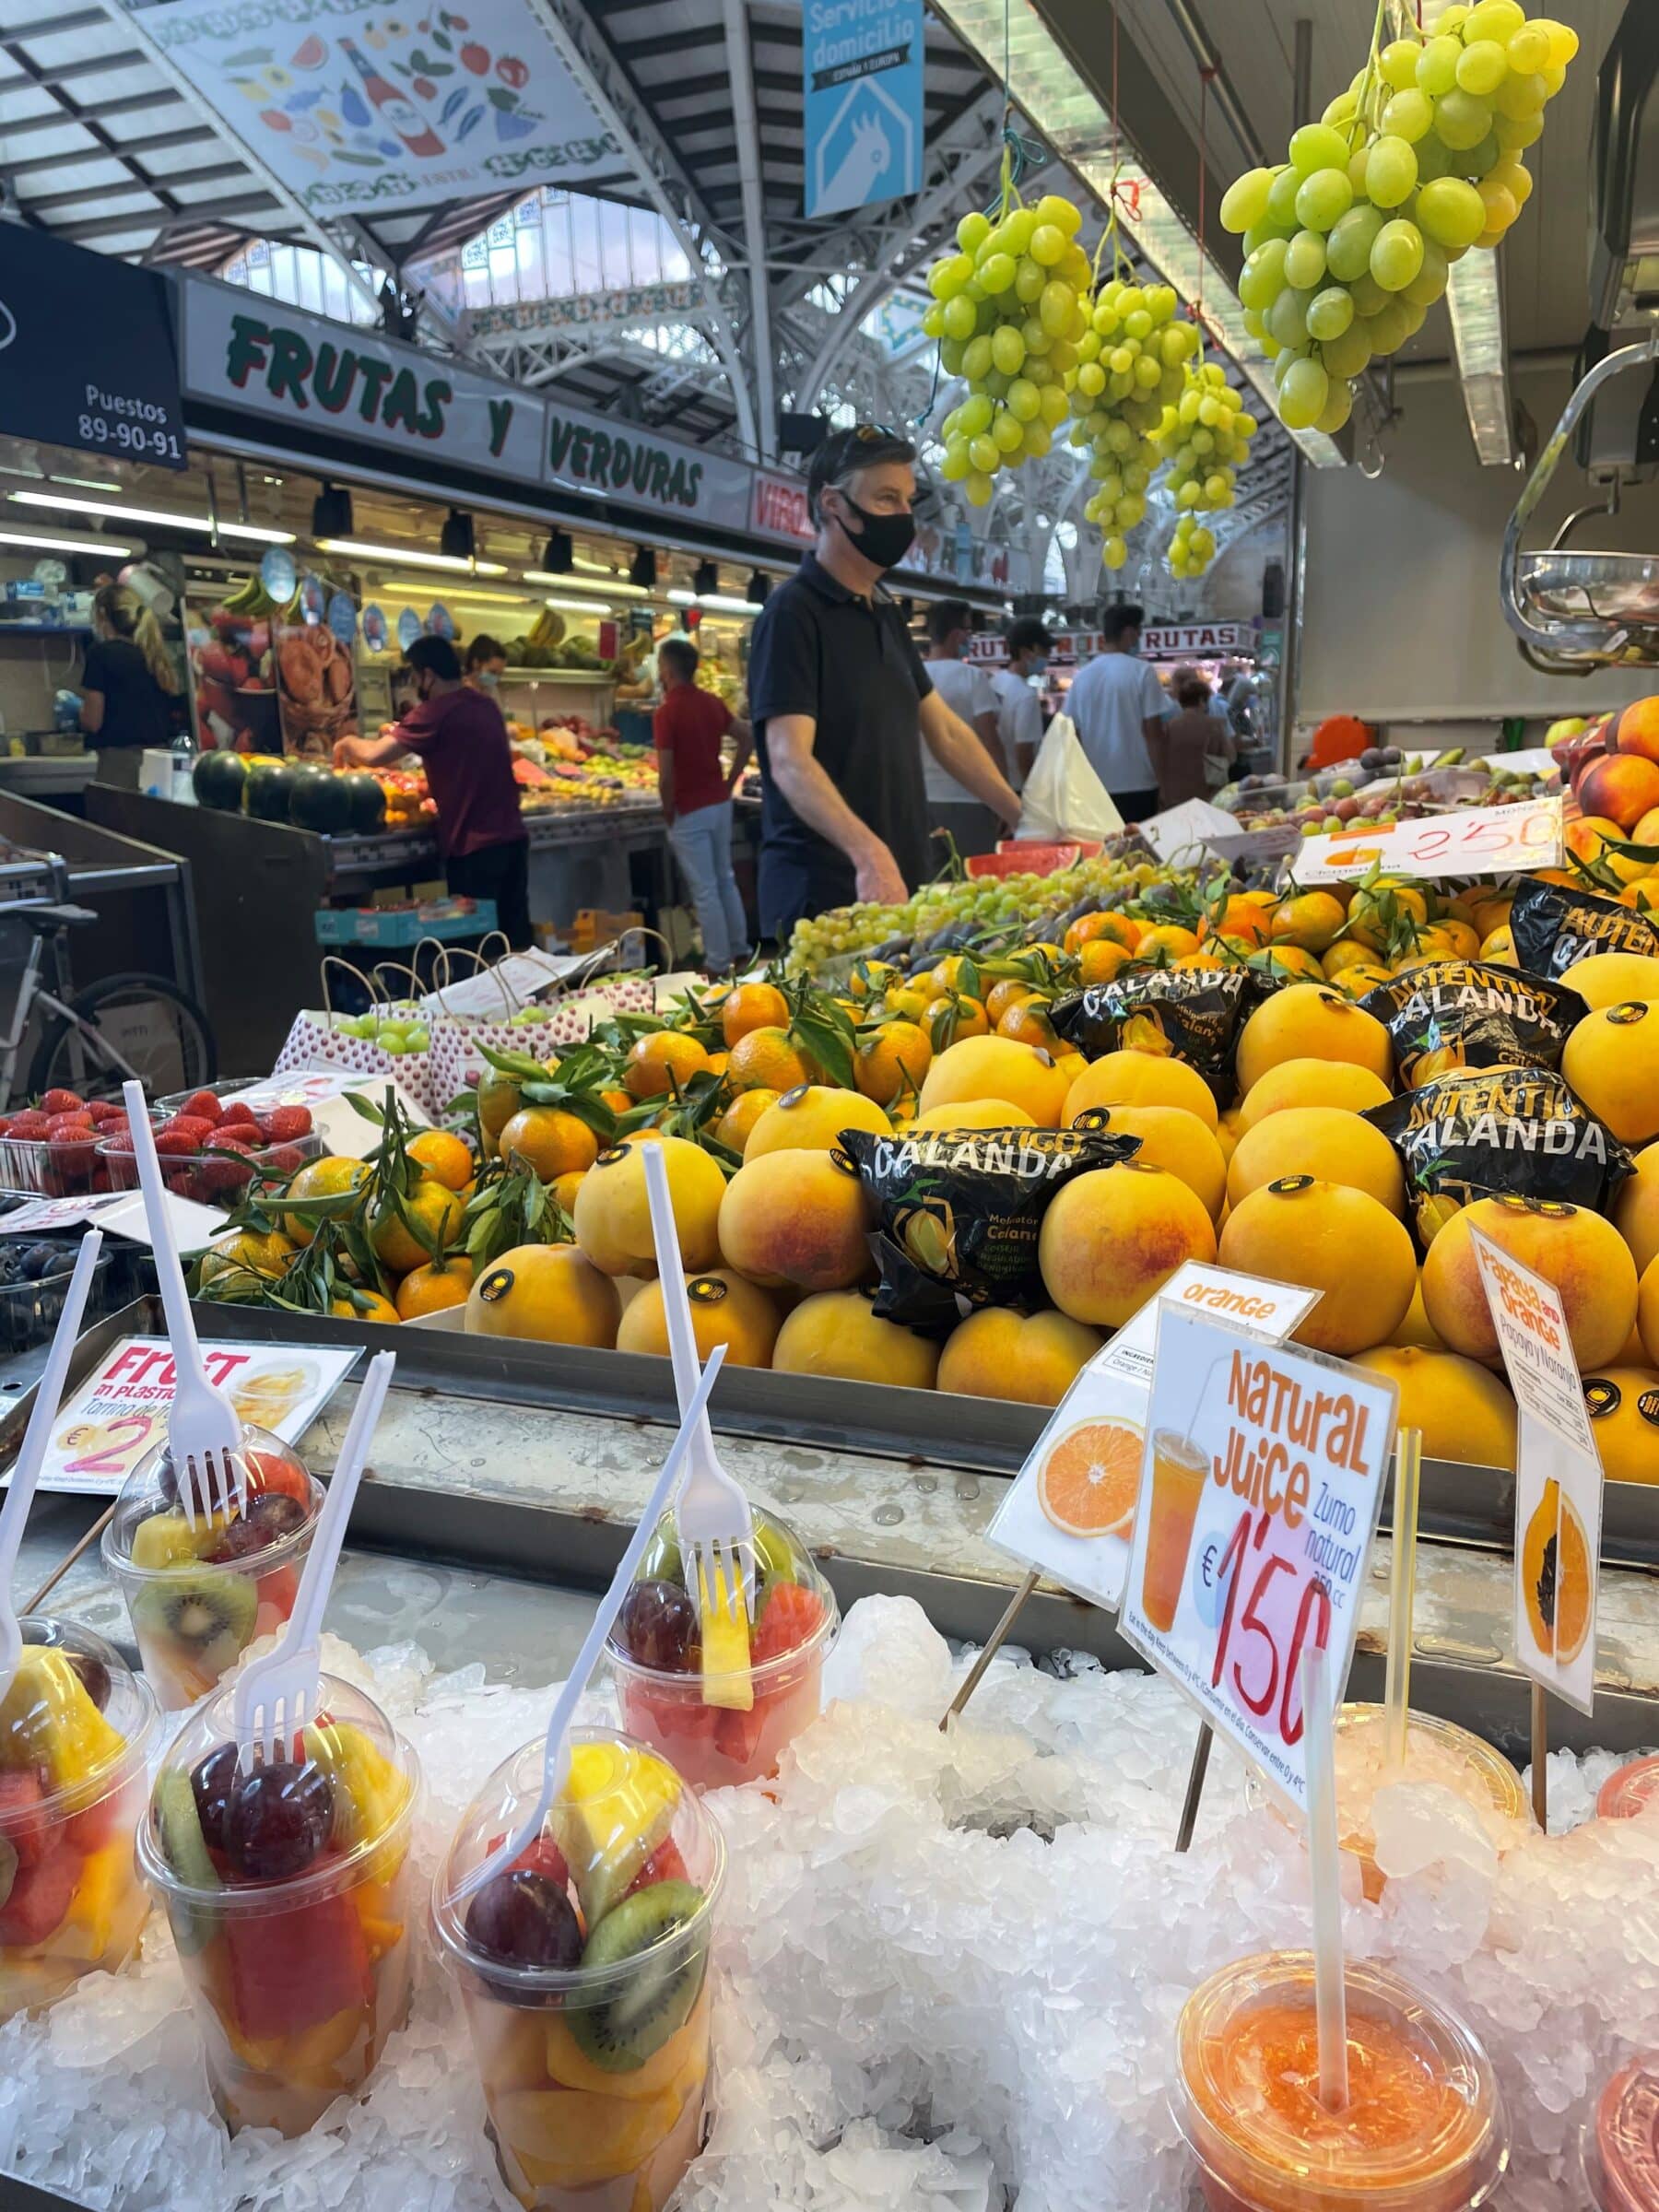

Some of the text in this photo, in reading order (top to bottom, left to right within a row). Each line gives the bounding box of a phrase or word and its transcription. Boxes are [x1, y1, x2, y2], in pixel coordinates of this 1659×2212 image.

[813, 15, 915, 70] domicilio
[86, 383, 167, 424] Puestos
[227, 314, 513, 457] FRUTAS Y
[78, 414, 182, 459] 89-90-91
[549, 417, 703, 507] VERDURAS
[1146, 628, 1235, 648] RUTAS
[876, 1141, 1073, 1180] CALANDA
[1500, 1313, 1534, 1358] Papaya
[1540, 1346, 1577, 1392] Naranja
[93, 1384, 113, 1395] in
[64, 1416, 152, 1473] 2
[1313, 1482, 1356, 1535] Zumo
[1304, 1529, 1362, 1584] natural
